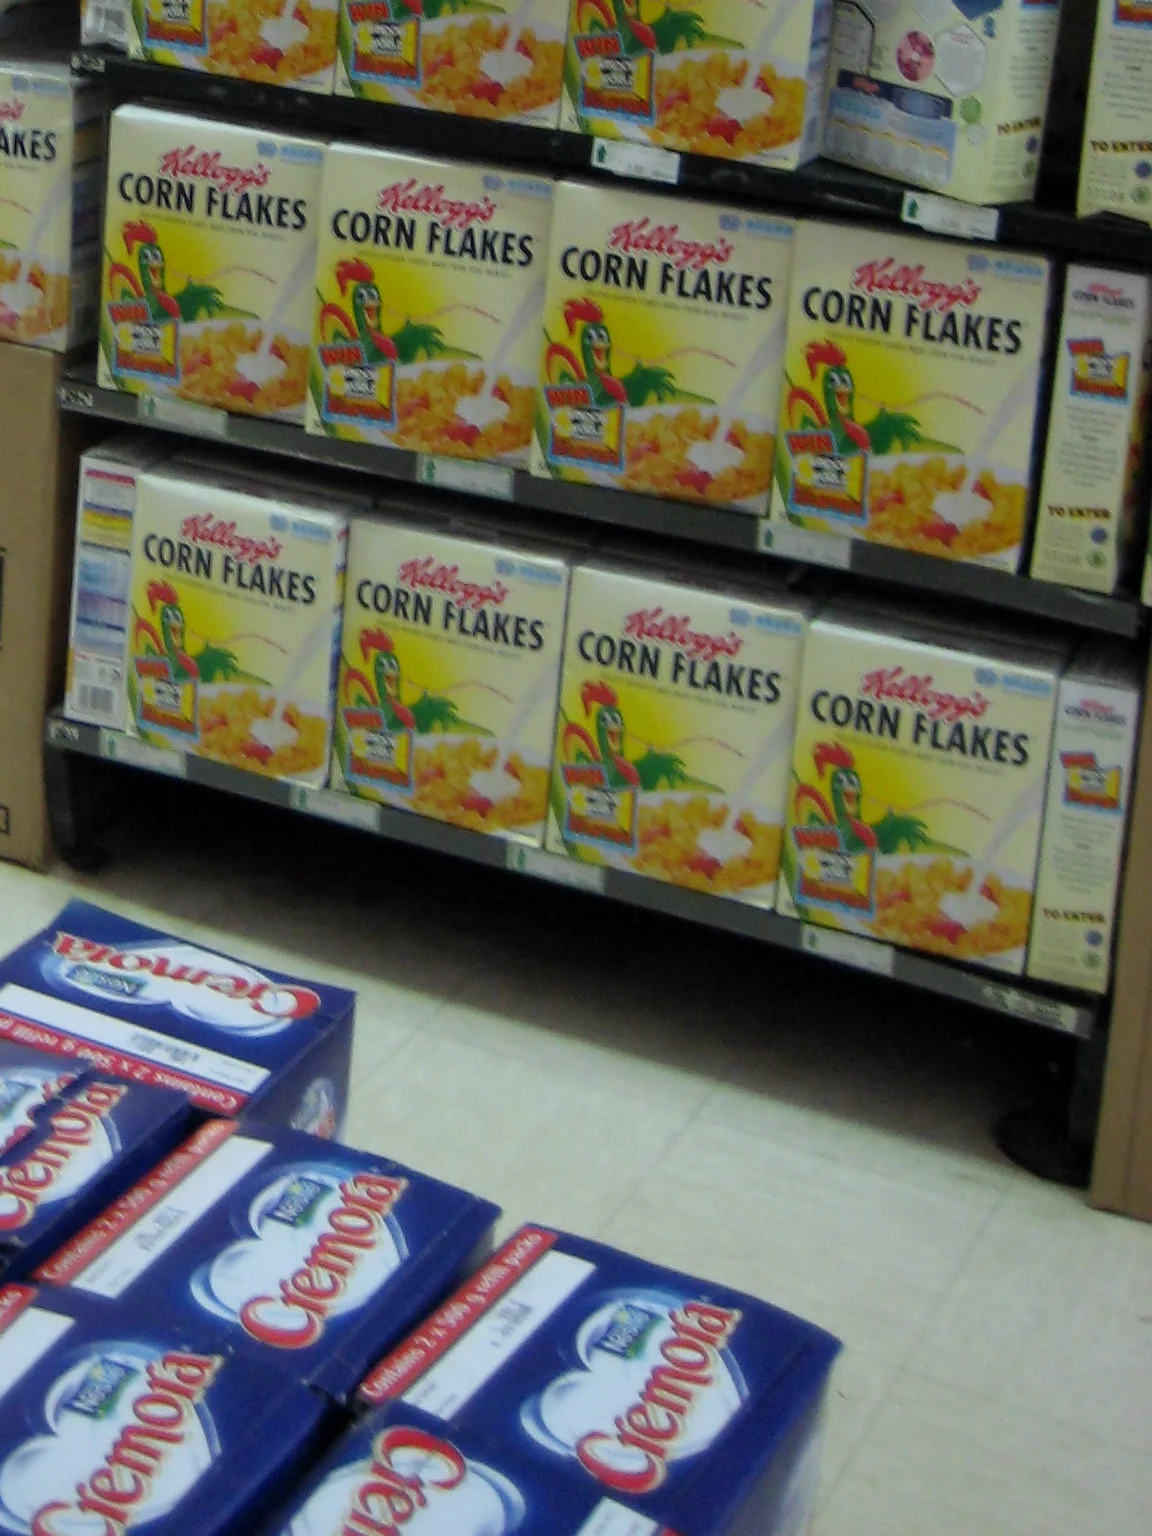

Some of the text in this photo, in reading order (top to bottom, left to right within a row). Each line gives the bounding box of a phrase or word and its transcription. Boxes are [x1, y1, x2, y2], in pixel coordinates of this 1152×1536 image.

[160, 144, 271, 194] Kellogg's
[118, 173, 308, 231] CORN FLAKES
[377, 176, 497, 229] Kellogg's
[331, 209, 535, 267] CORN FLAKES
[608, 216, 735, 271] Kellogg's
[560, 246, 773, 311] CORN FLAKES
[851, 257, 983, 314] Kellogg's
[801, 285, 1023, 355] CORN FLAKES
[788, 433, 833, 455] WIN
[180, 512, 283, 564] Kellogg's
[143, 532, 318, 606] CORN FLAKES
[398, 555, 510, 610] Kellogg's
[356, 579, 545, 651] CORN FLAKES
[622, 606, 744, 662] Kellogg's
[577, 630, 782, 704] CORN FLAKES
[860, 665, 991, 722] Kellogg's
[810, 689, 1030, 765] CORN FLAKES
[53, 929, 323, 1022] Cremora
[237, 1170, 410, 1351] Cremora
[575, 1296, 745, 1495] Cremora
